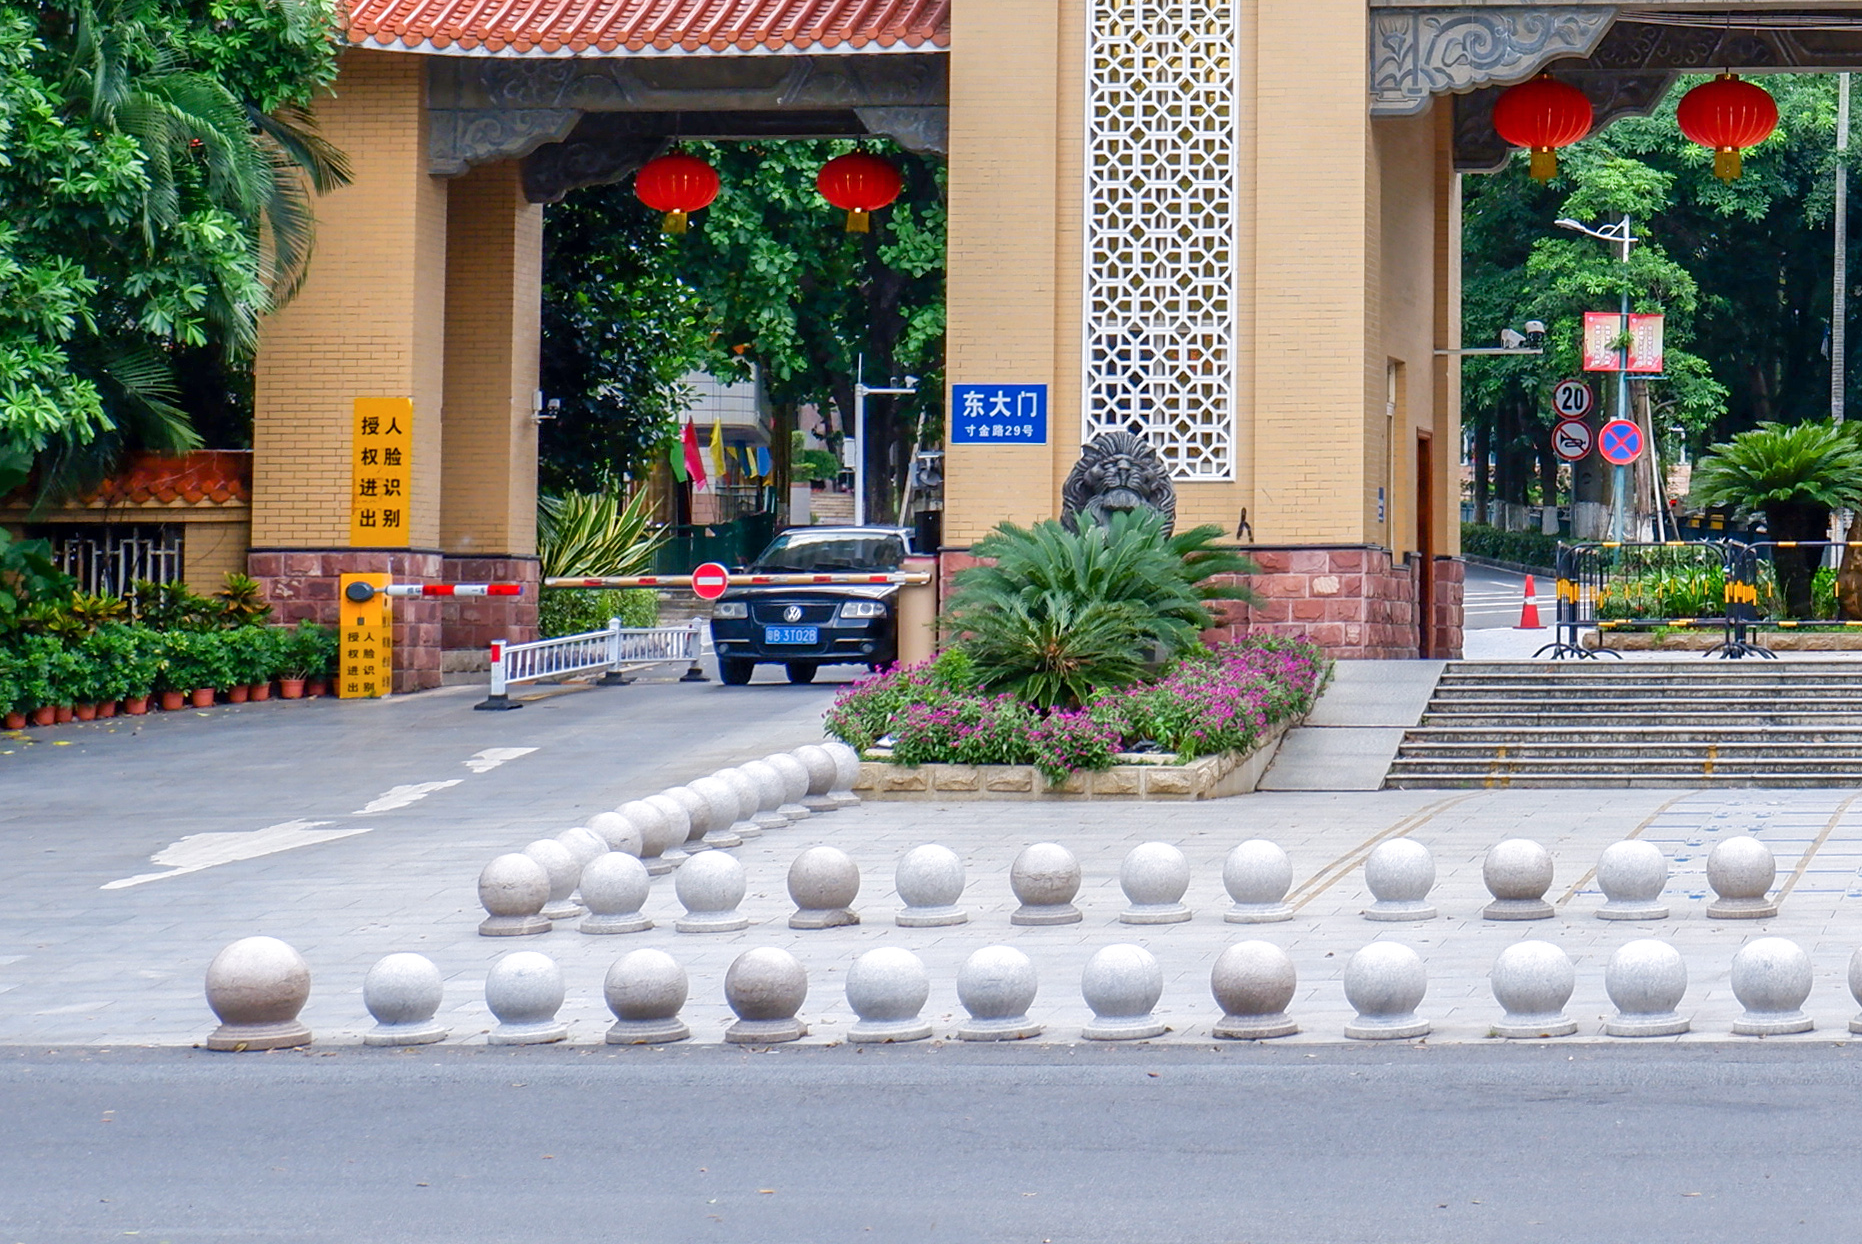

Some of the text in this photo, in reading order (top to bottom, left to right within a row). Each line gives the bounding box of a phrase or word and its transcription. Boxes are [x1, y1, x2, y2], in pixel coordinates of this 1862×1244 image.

[963, 390, 1037, 417] 东大门
[1562, 386, 1584, 411] 20
[964, 424, 1033, 437] 寸金路29号
[359, 416, 380, 527] 授权进出
[382, 416, 402, 527] 人脸识别
[347, 632, 359, 693] 授权进出
[363, 632, 375, 692] 人脸识别
